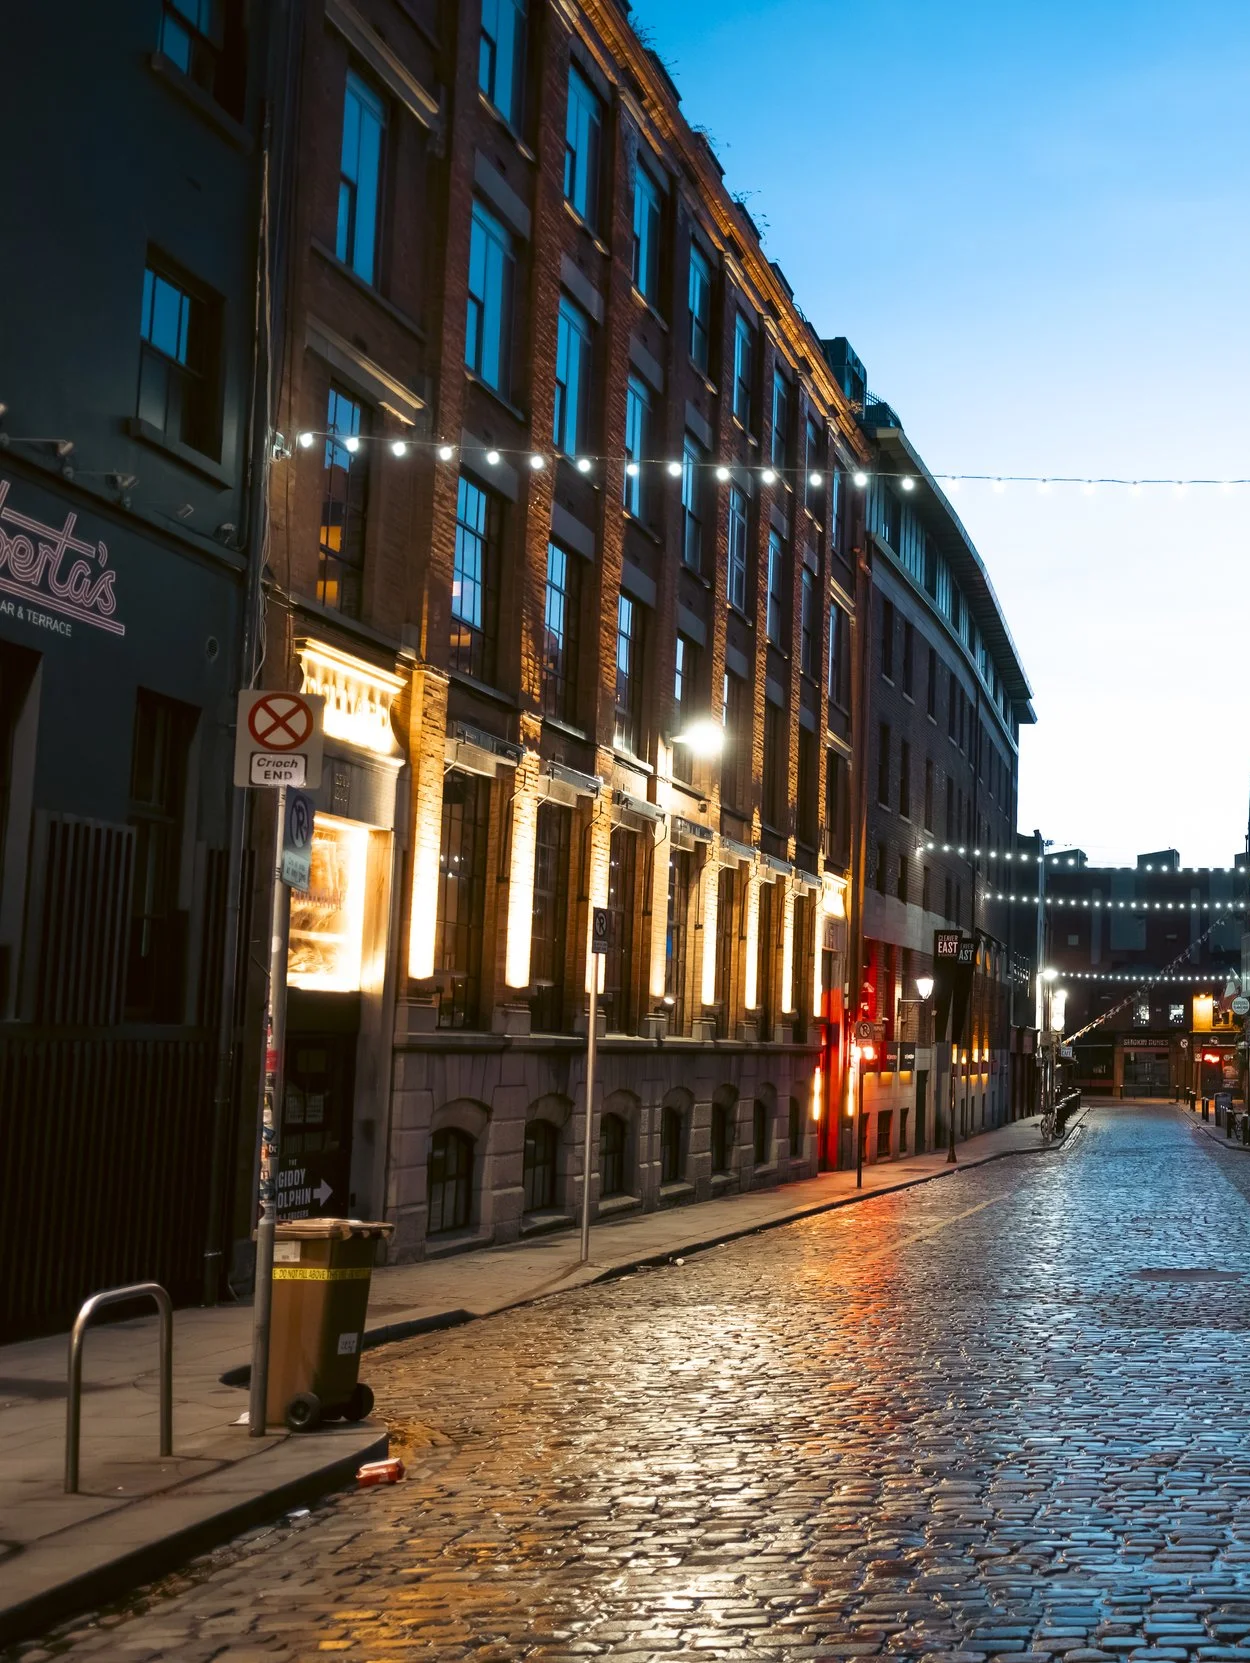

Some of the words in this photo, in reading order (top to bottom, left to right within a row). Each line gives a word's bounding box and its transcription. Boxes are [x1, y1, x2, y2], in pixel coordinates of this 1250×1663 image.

[17, 606, 24, 620] &
[26, 608, 72, 637] TERRACE
[264, 770, 293, 780] END
[938, 941, 958, 954] EAST
[958, 949, 974, 961] AST
[278, 1168, 306, 1189] GIDDY
[277, 1187, 311, 1209] OLPHIN
